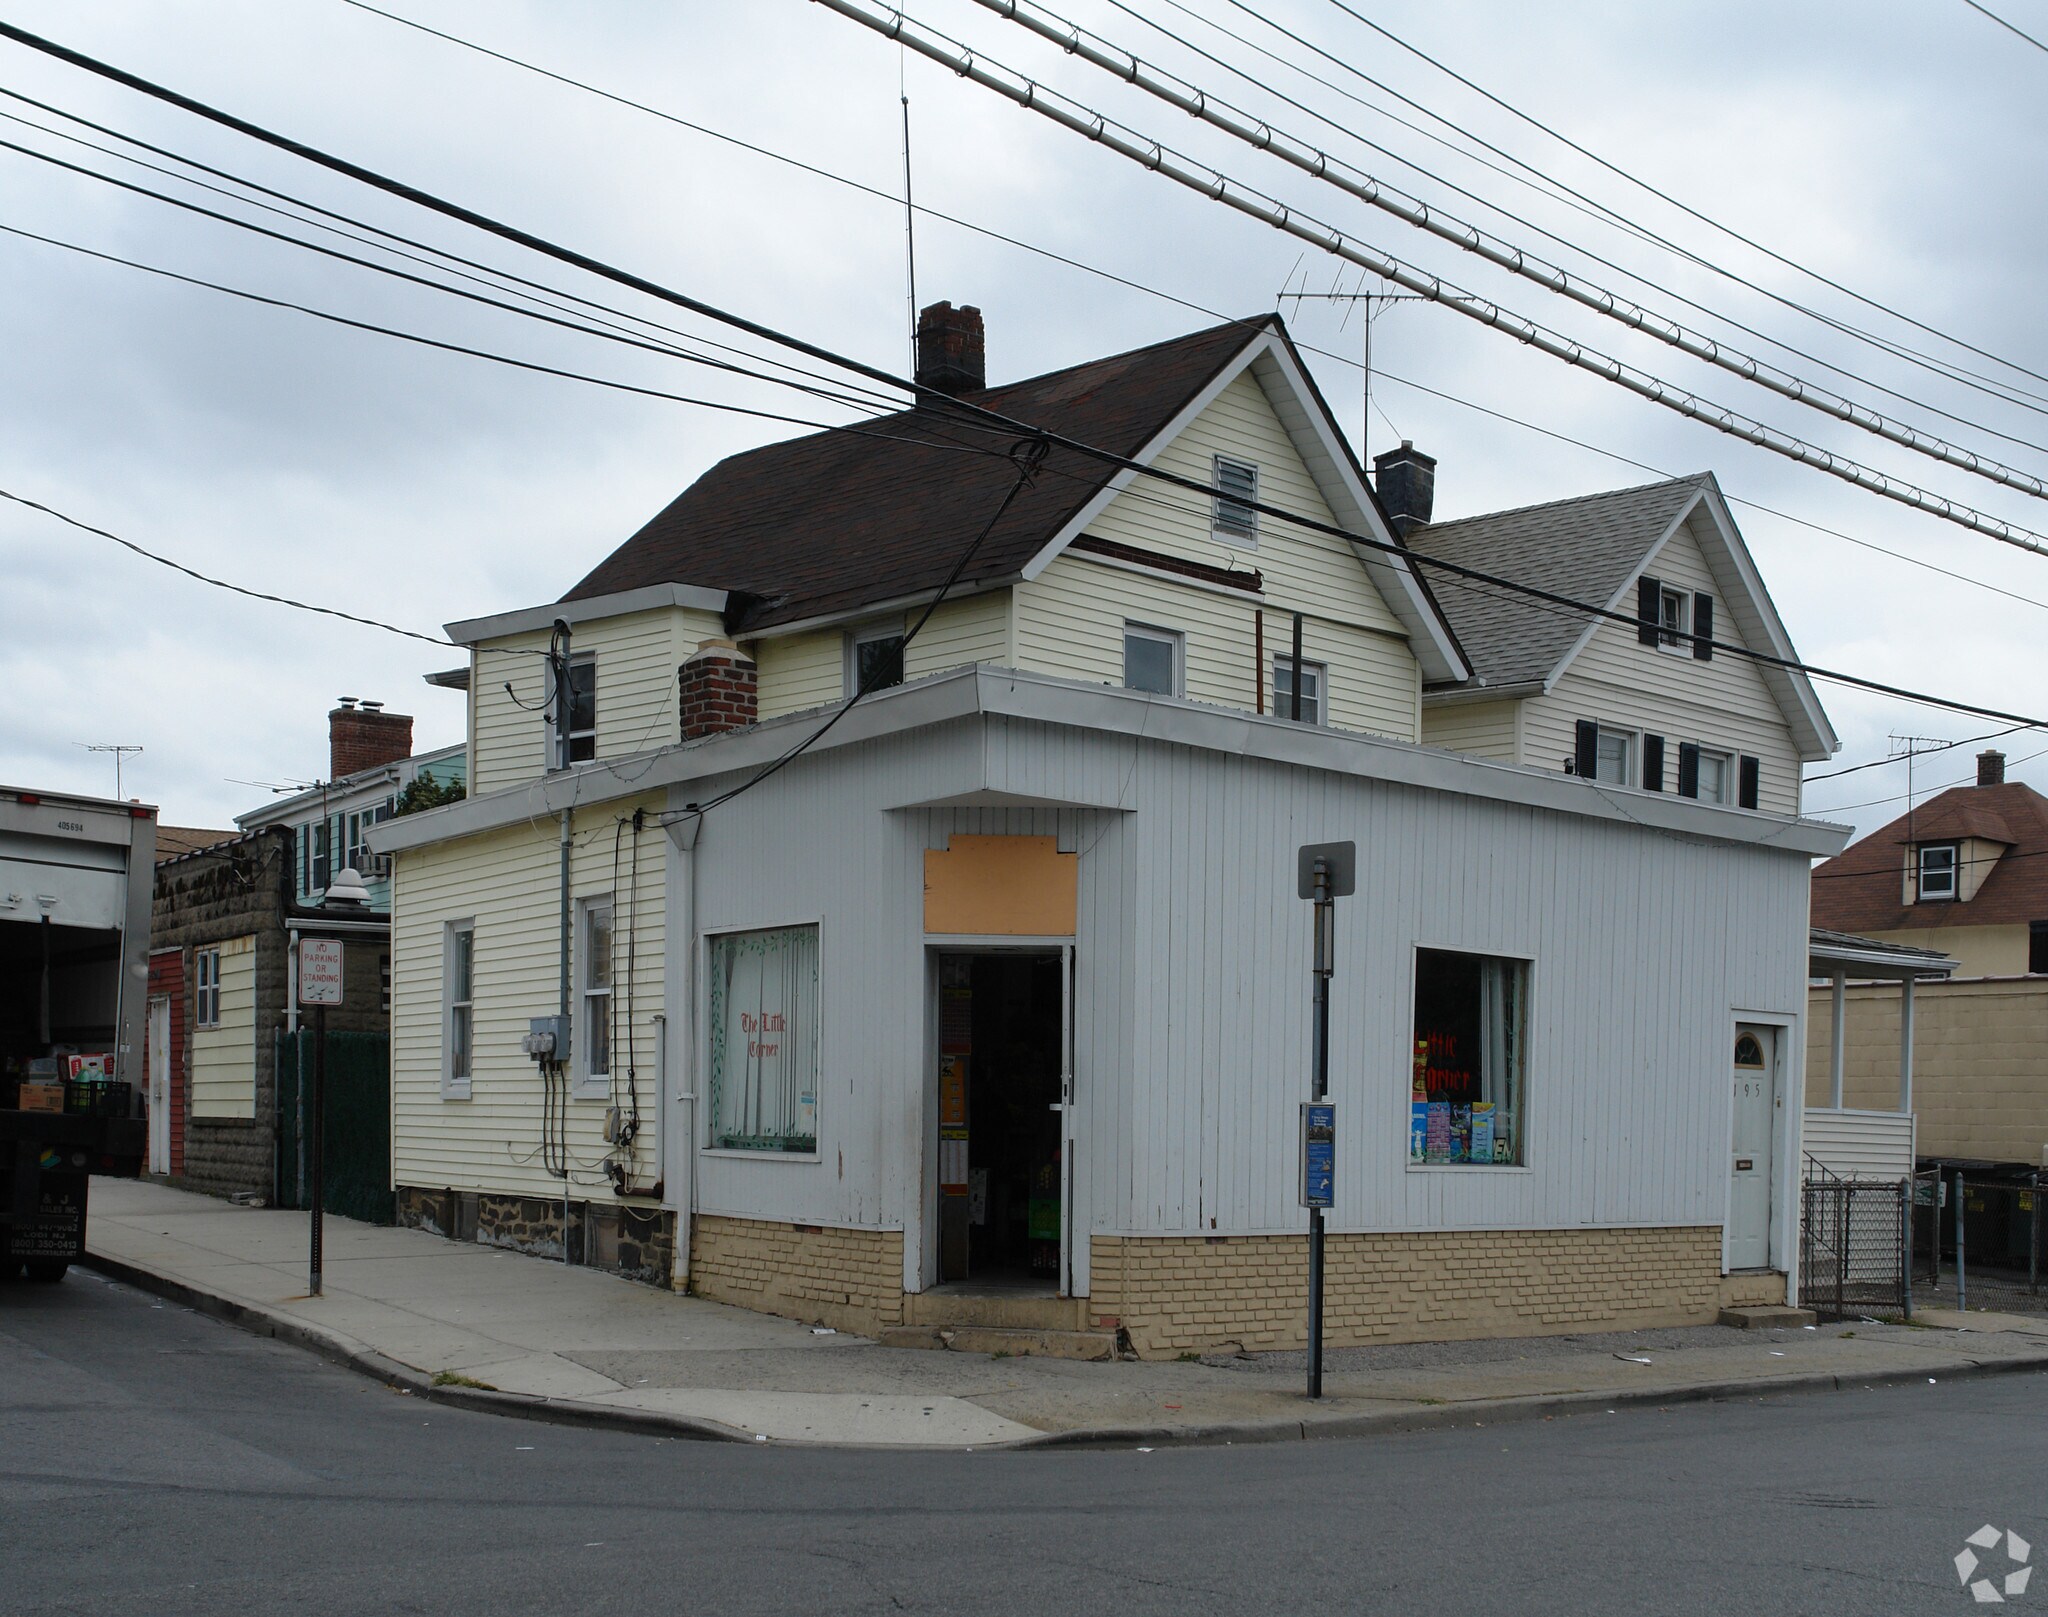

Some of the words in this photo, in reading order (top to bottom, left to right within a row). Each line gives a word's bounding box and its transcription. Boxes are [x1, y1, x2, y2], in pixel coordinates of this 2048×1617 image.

[57, 821, 84, 832] 405694
[316, 944, 327, 952] NO
[304, 954, 338, 963] PARKING
[315, 964, 327, 972] OR
[303, 974, 339, 983] STANDING
[741, 1012, 758, 1033] The
[761, 1012, 786, 1033] Little
[749, 1041, 779, 1058] Corner
[39, 1205, 63, 1213] SALES
[11, 1238, 34, 1249] (800)
[38, 1239, 77, 1249] 350-0413
